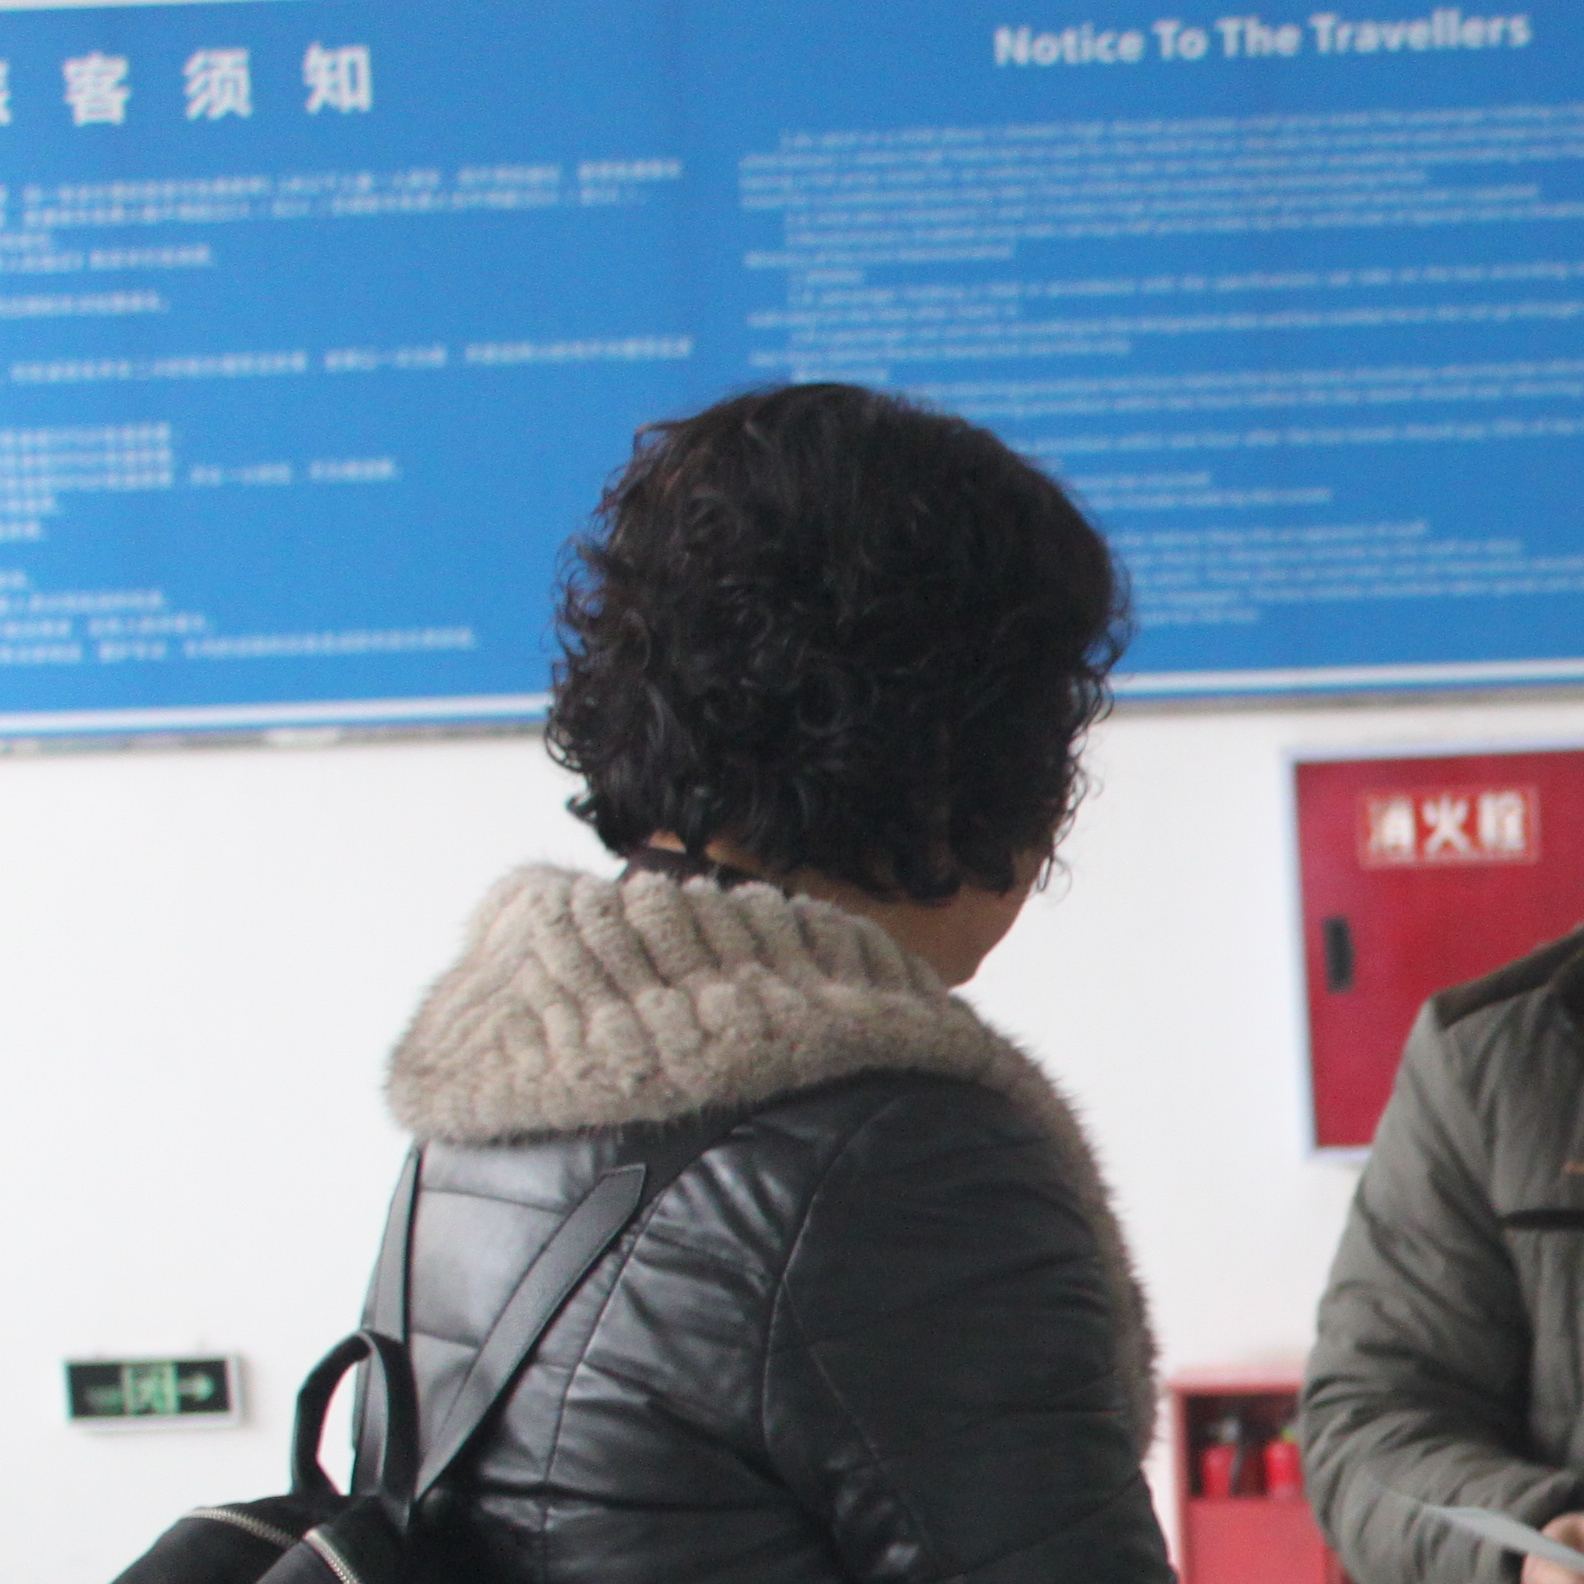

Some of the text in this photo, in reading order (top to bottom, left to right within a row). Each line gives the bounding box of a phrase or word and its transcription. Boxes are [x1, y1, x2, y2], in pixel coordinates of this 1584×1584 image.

[995, 7, 1532, 66] Notice To The Travellers
[0, 43, 373, 127] 客须知
